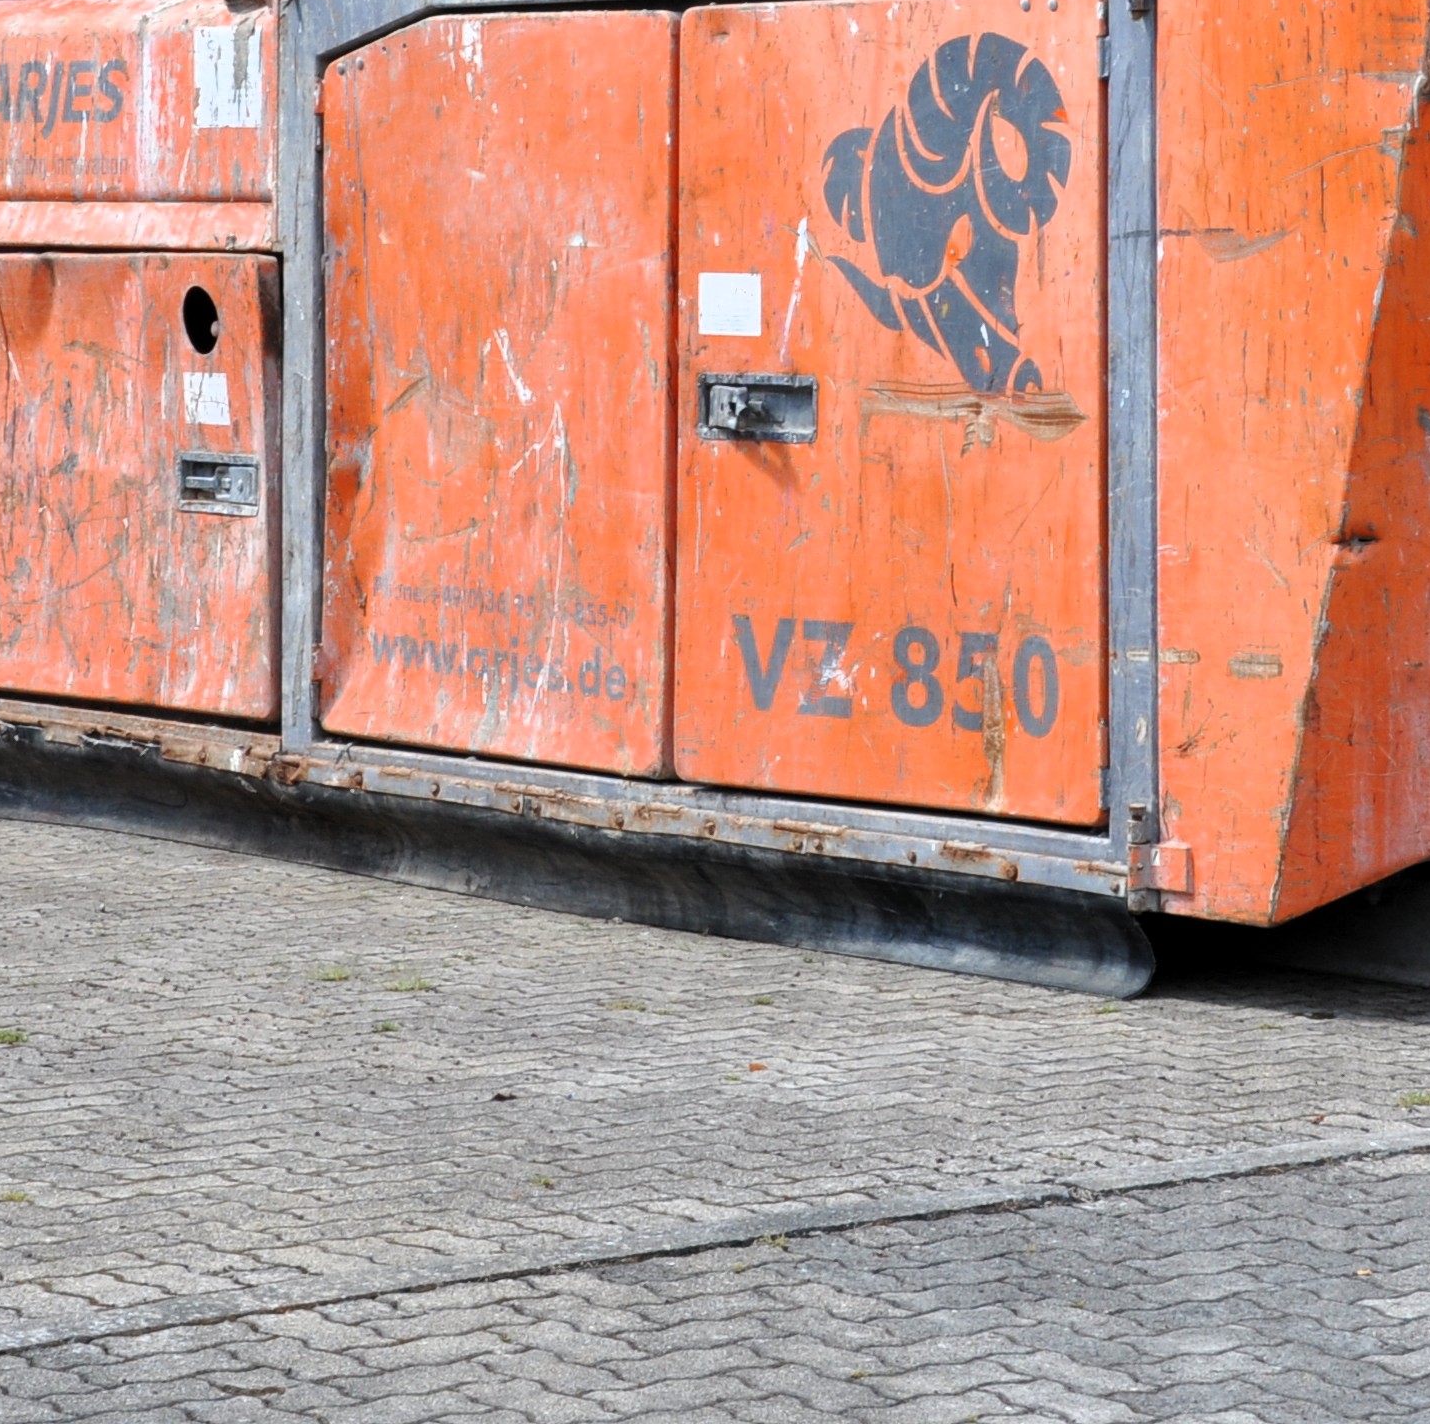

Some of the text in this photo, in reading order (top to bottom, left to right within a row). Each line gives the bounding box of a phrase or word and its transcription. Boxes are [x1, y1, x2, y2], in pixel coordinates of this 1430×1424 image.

[371, 631, 627, 701] www.arjes.de
[731, 613, 1059, 739] VZ 850
